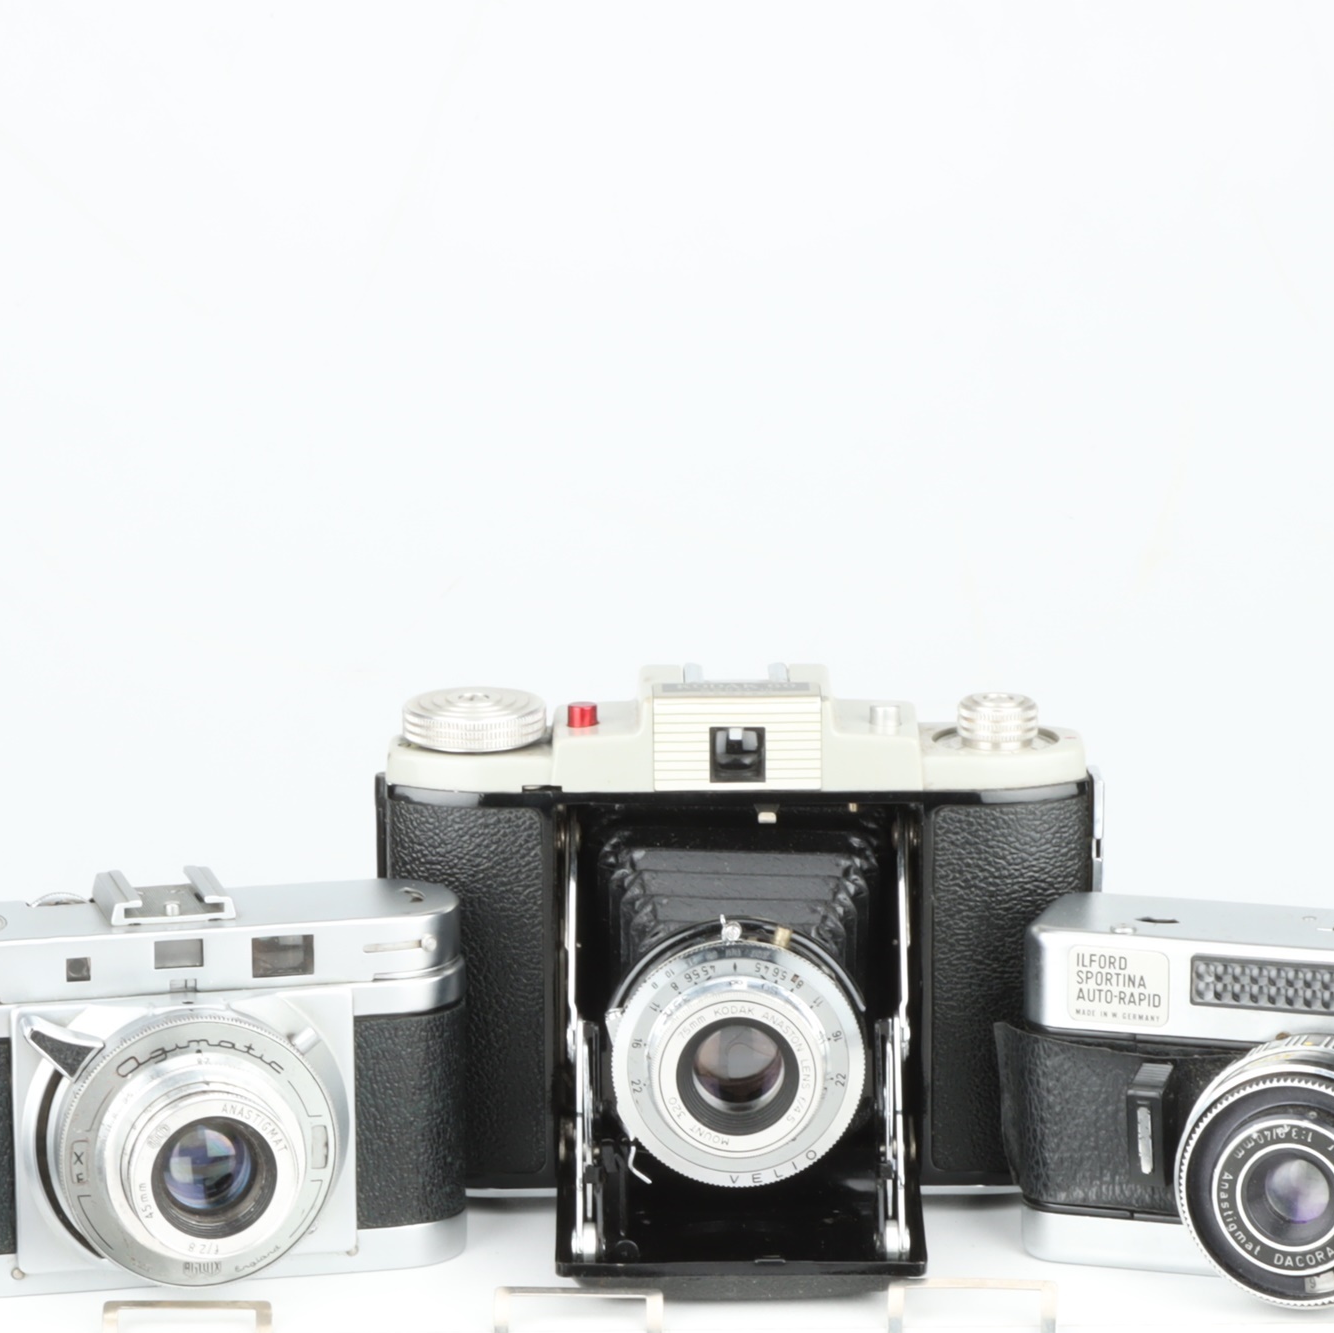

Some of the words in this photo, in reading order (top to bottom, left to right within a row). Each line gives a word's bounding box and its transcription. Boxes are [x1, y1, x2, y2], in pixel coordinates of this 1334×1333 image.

[1076, 953, 1127, 971] ILFORD
[1076, 970, 1148, 990] SPORTINA
[1076, 987, 1162, 1009] AUTO-RAPID
[1075, 1008, 1096, 1017] MADE
[1100, 1010, 1109, 1018] IN
[1122, 1012, 1161, 1023] GERMANY
[631, 1037, 643, 1049] 16
[831, 1030, 843, 1043] 16
[677, 1015, 706, 1040] 75mm
[713, 1004, 755, 1018] KODAK
[761, 1011, 803, 1053] ANASTON
[799, 1058, 812, 1090] LENS
[630, 1078, 643, 1094] 22
[834, 1072, 847, 1087] 22
[668, 1096, 687, 1120] 320
[221, 1102, 289, 1153] ANASTIGMAT
[688, 1119, 730, 1147] MOUNT
[73, 1151, 84, 1166] X
[728, 1148, 819, 1185] VELIO
[1219, 1171, 1261, 1256] Anastigmat
